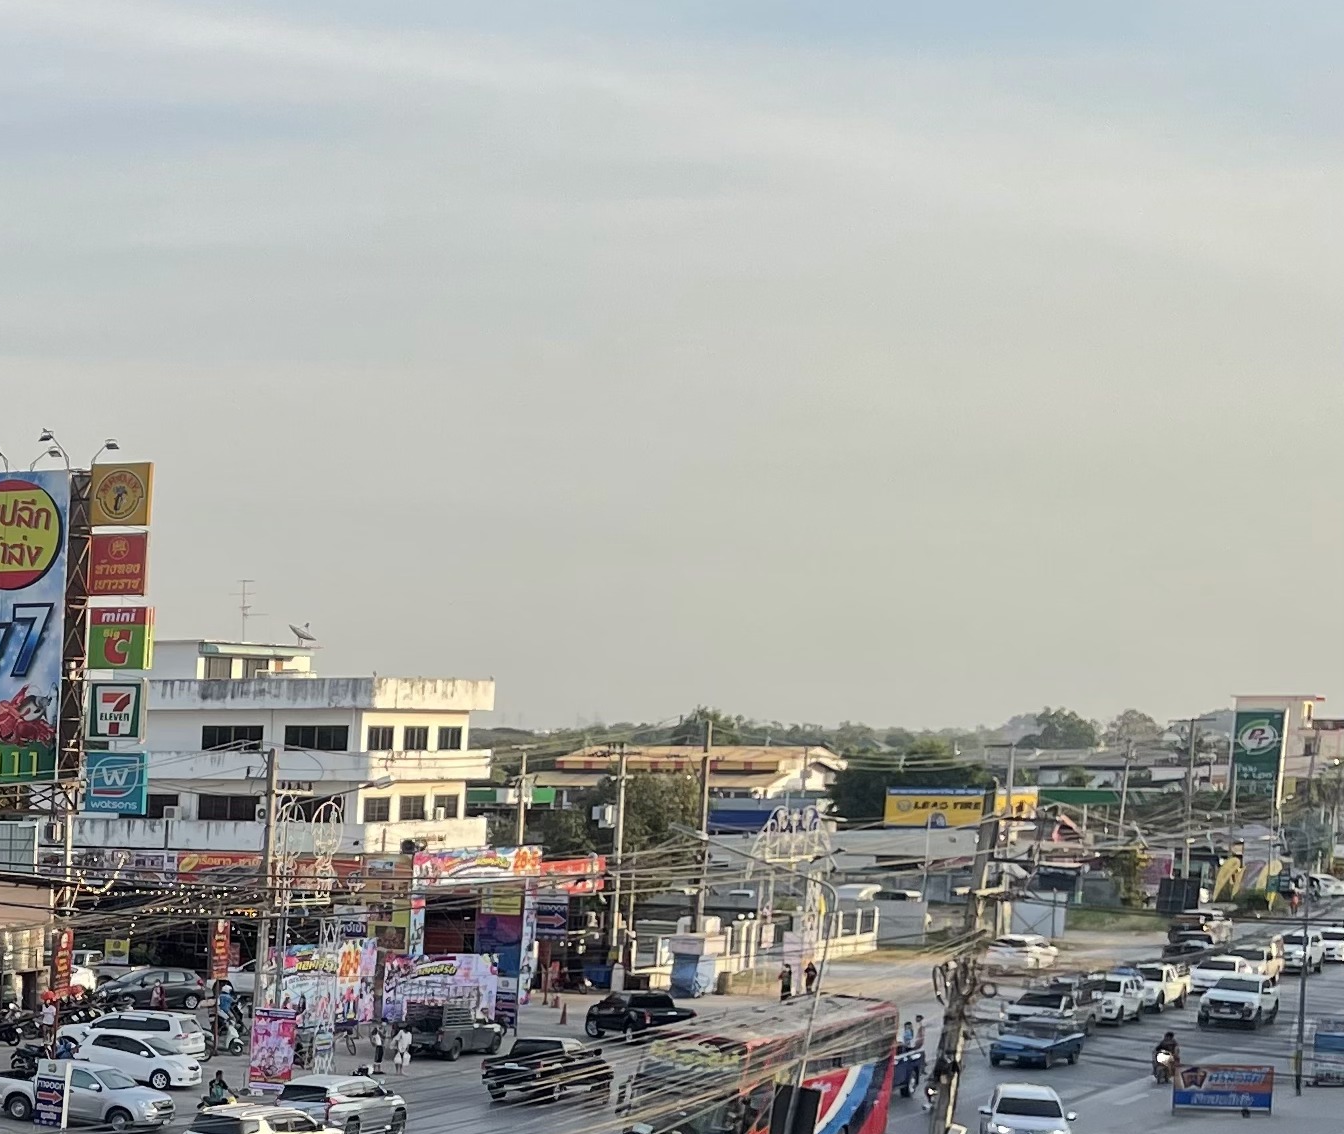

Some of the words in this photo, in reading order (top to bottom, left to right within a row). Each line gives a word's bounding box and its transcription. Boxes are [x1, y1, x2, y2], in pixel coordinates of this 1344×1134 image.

[101, 608, 136, 624] mini
[103, 629, 133, 666] C
[90, 799, 138, 811] watsons
